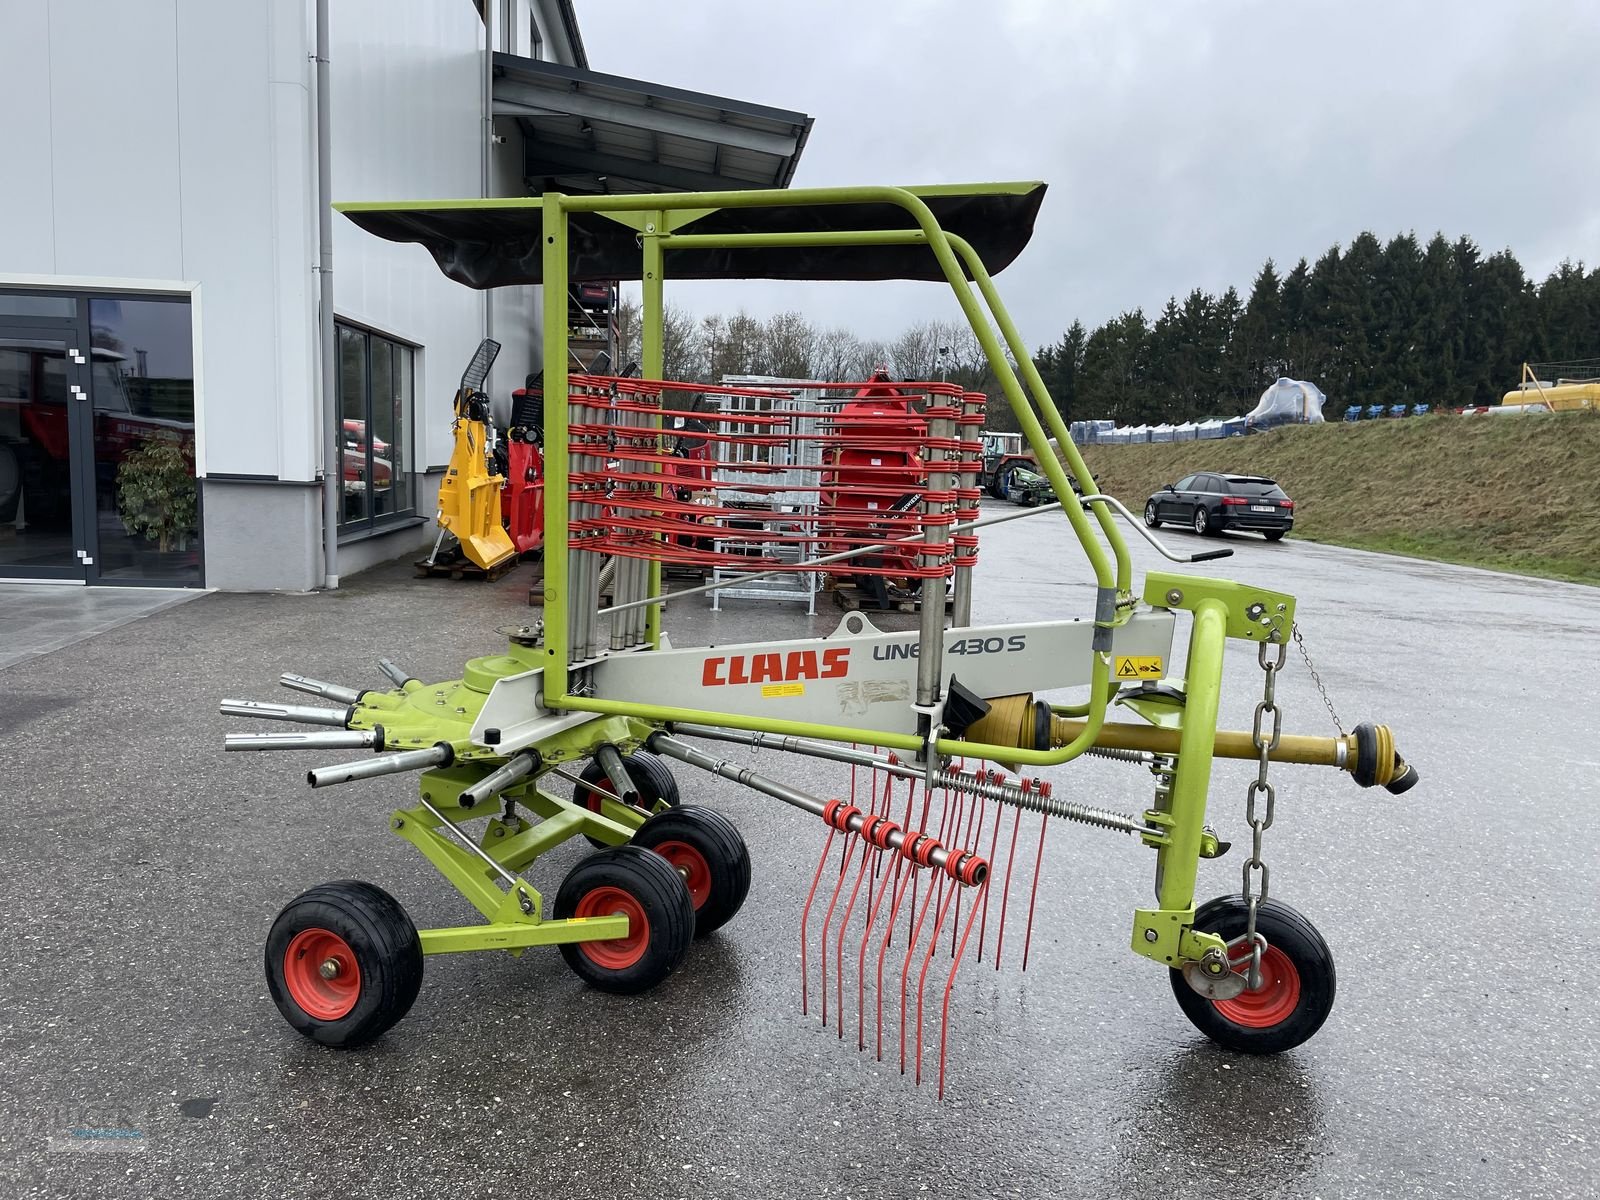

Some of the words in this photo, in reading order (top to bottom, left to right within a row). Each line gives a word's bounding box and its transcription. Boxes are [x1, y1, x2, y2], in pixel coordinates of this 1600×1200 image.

[873, 643, 920, 661] LINE
[948, 638, 1004, 655] 430
[1007, 635, 1026, 652] S
[702, 648, 850, 687] CLAAS
